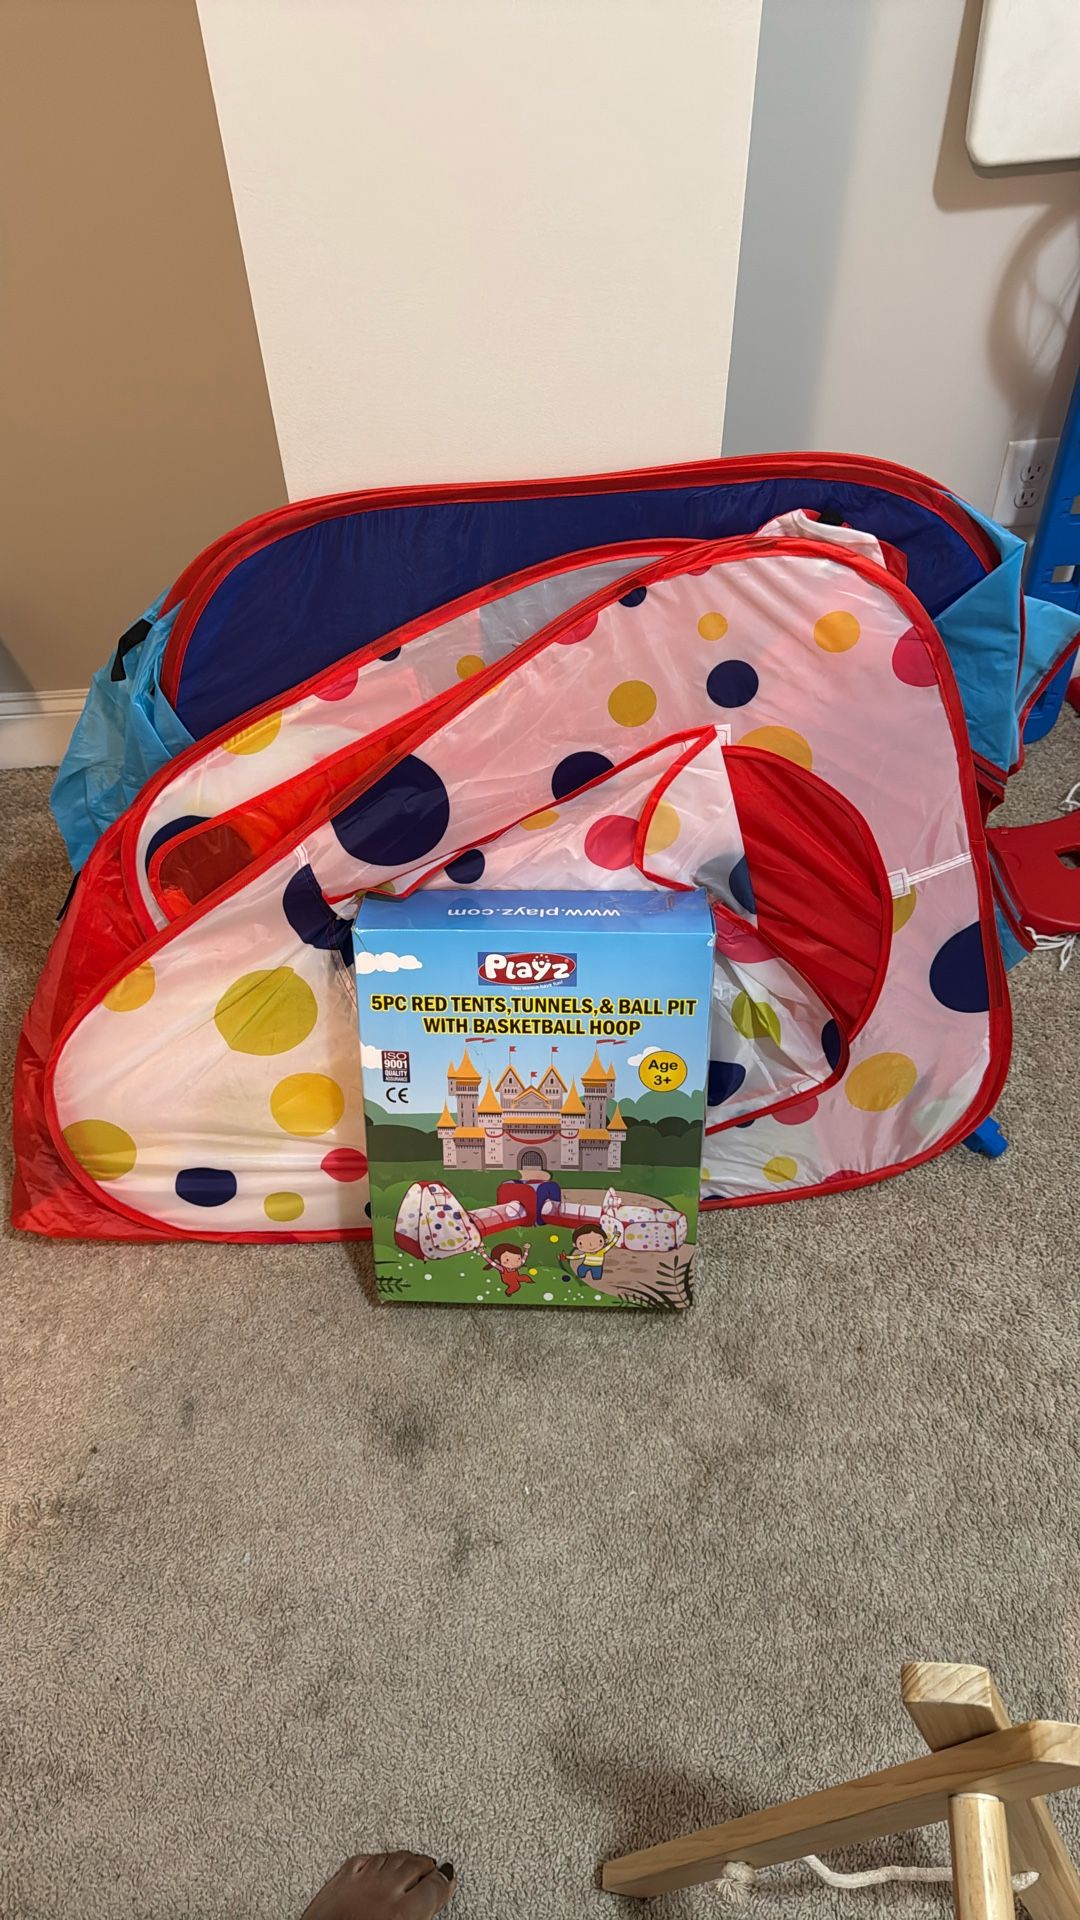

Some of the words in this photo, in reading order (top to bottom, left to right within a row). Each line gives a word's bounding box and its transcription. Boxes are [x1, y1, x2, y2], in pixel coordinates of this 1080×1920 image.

[447, 906, 621, 918] www.playz.com
[484, 954, 570, 981] Playz
[370, 995, 408, 1011] 5PC
[411, 996, 448, 1012] RED
[618, 999, 663, 1015] BALL
[667, 1000, 697, 1015] PIT
[423, 1017, 468, 1033] WITH
[473, 1018, 585, 1035] BASKETBALL
[589, 1020, 641, 1035] HOOP
[384, 1052, 407, 1060] ISO
[384, 1060, 407, 1068] 9001
[648, 1059, 678, 1073] Age
[653, 1075, 672, 1086] 3+
